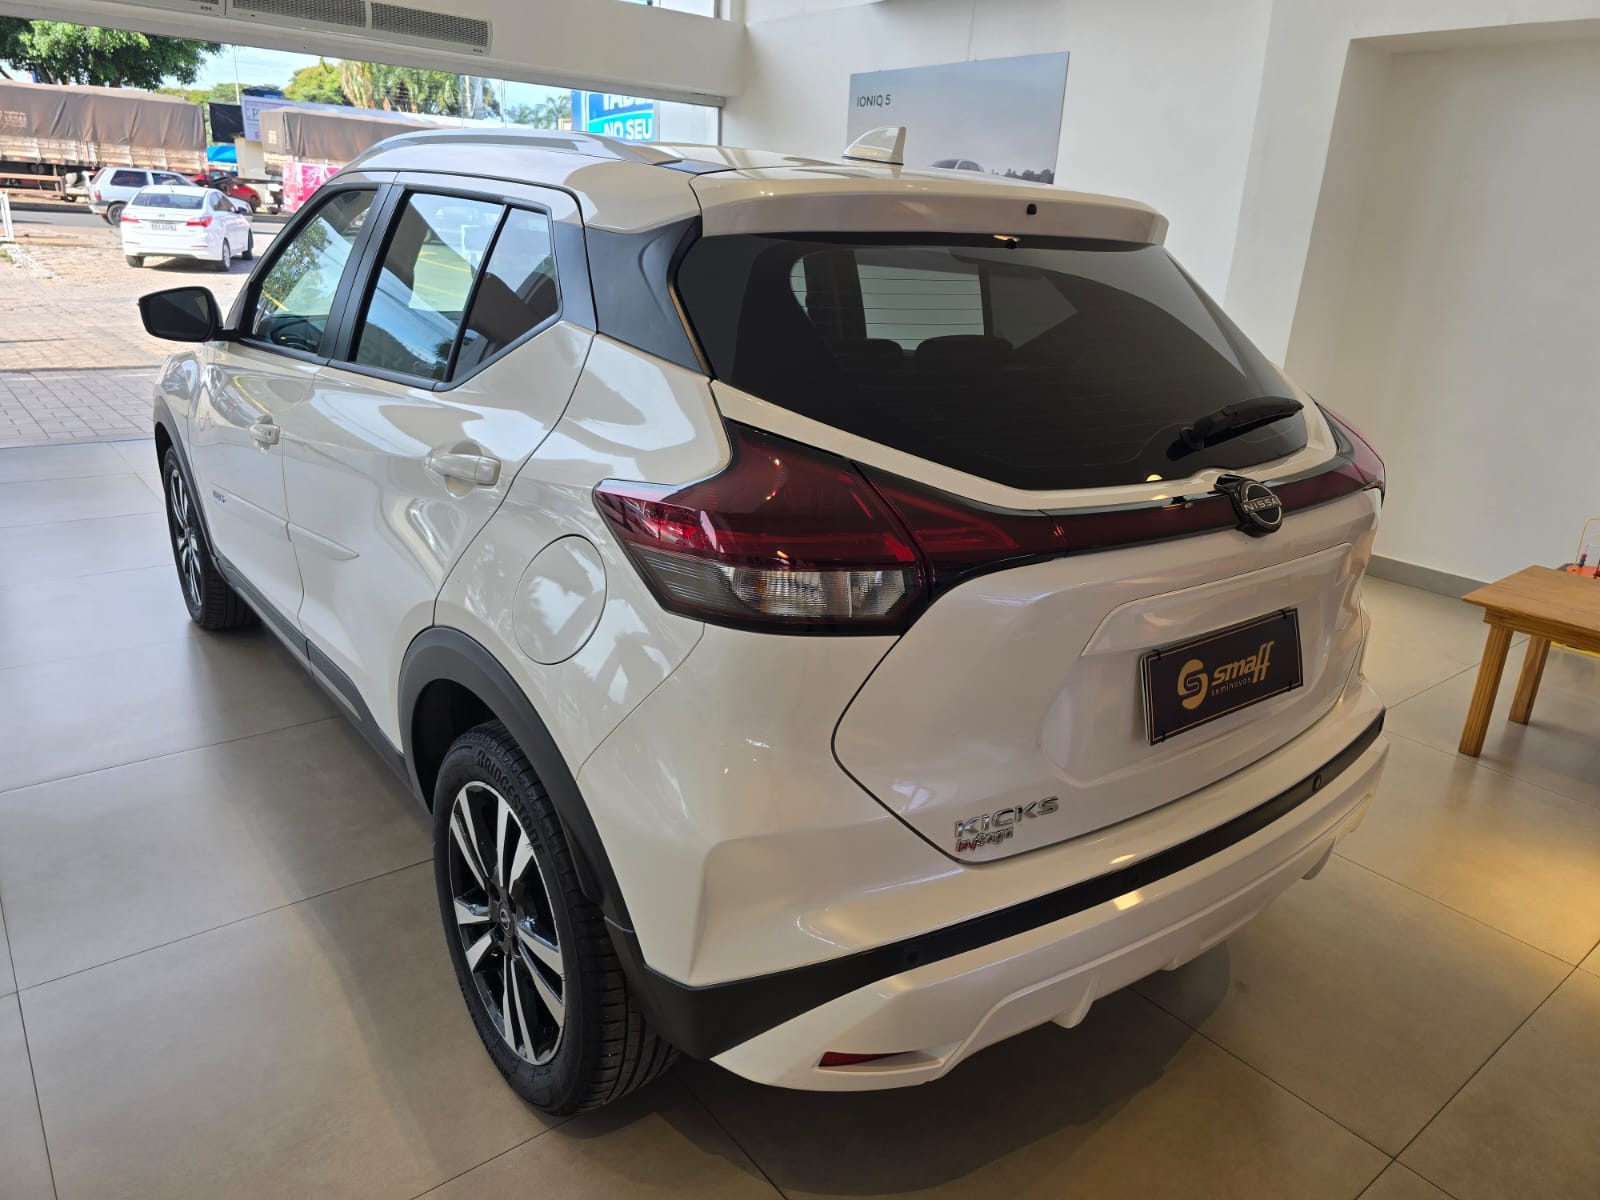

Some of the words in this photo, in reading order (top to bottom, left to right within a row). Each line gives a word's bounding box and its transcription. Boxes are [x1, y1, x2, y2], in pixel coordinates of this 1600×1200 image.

[856, 95, 884, 108] IONIQ
[885, 94, 892, 106] 5
[626, 118, 653, 140] SEU
[1243, 496, 1279, 512] NISSA
[1211, 677, 1252, 697] seminovos
[954, 795, 1060, 838] KICKS
